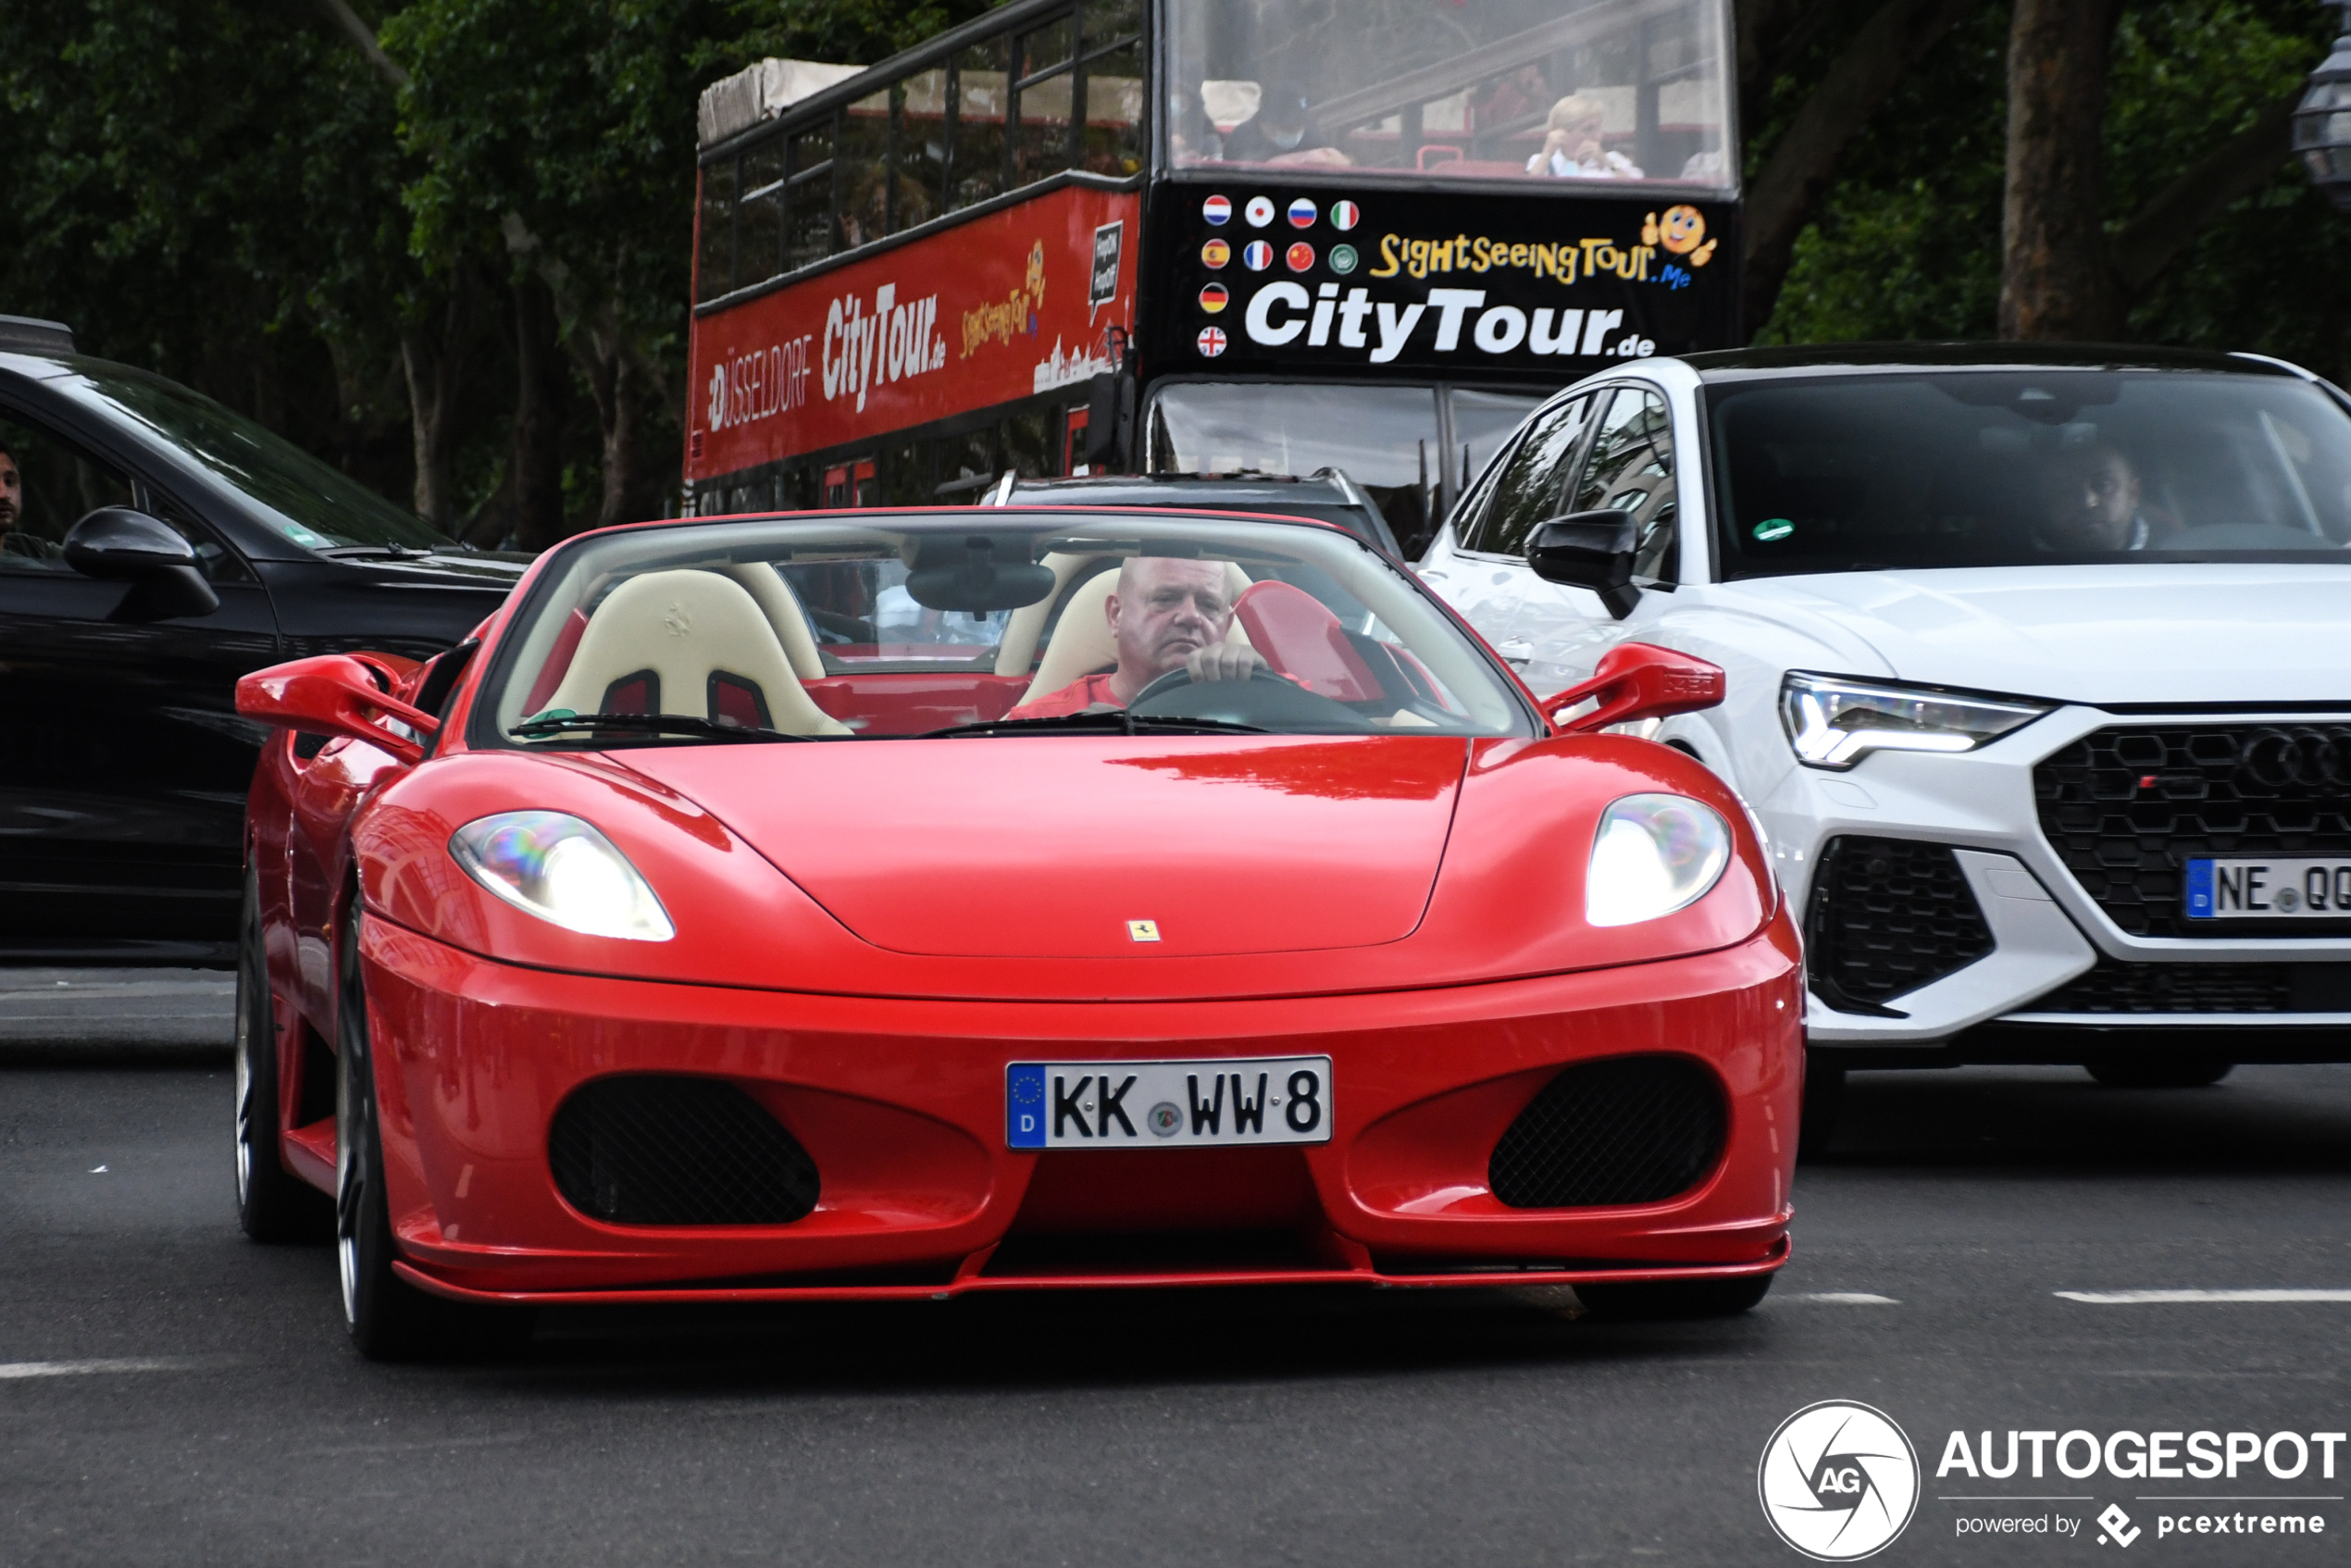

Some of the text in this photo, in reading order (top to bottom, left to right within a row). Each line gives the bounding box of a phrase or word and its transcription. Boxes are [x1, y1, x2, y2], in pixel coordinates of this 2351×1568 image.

[822, 281, 947, 414] CityTour.de
[1245, 280, 1656, 363] CityTour.de
[2218, 865, 2271, 911] NE
[1020, 1114, 1035, 1132] D
[1053, 1076, 1138, 1138] KK
